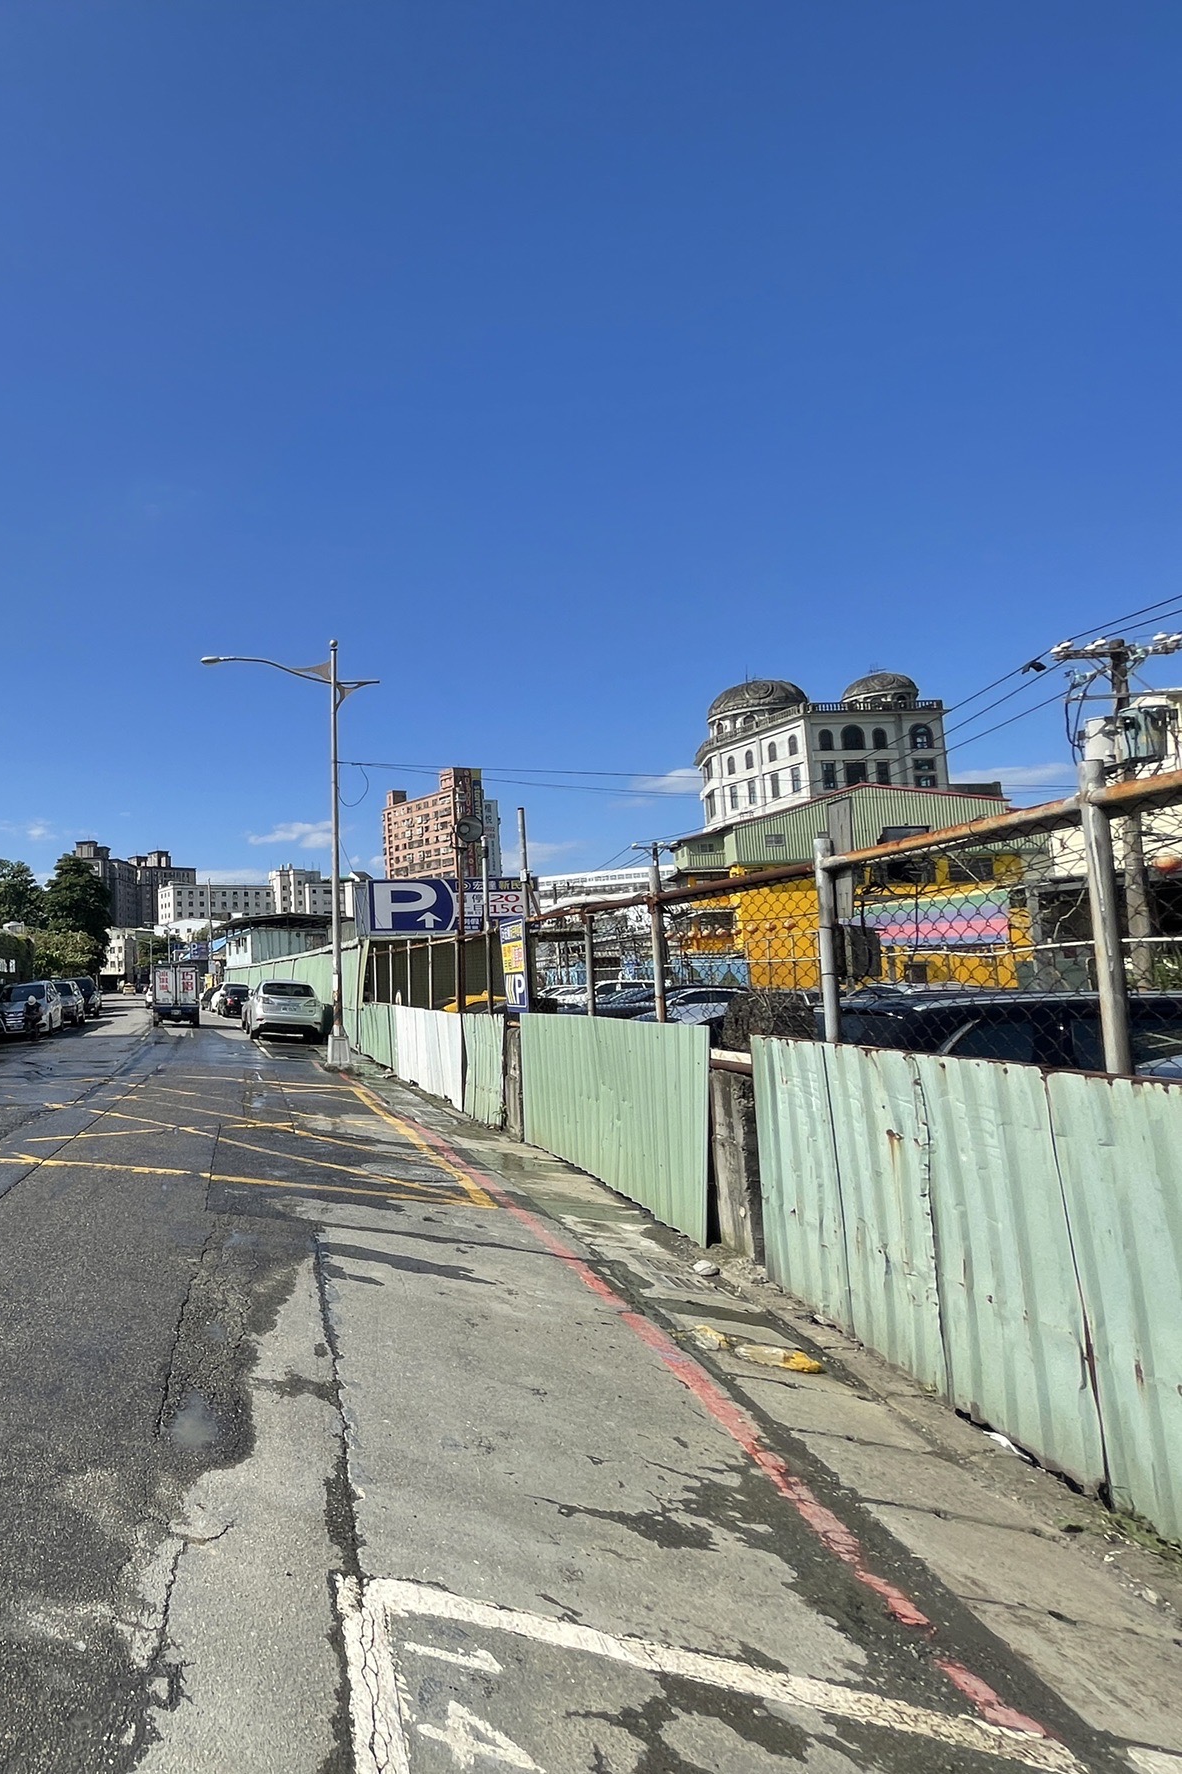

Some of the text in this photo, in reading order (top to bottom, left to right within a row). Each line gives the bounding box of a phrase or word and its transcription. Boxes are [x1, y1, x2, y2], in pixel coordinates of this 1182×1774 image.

[373, 883, 437, 930] P
[490, 894, 520, 903] 20
[515, 974, 526, 1005] P
